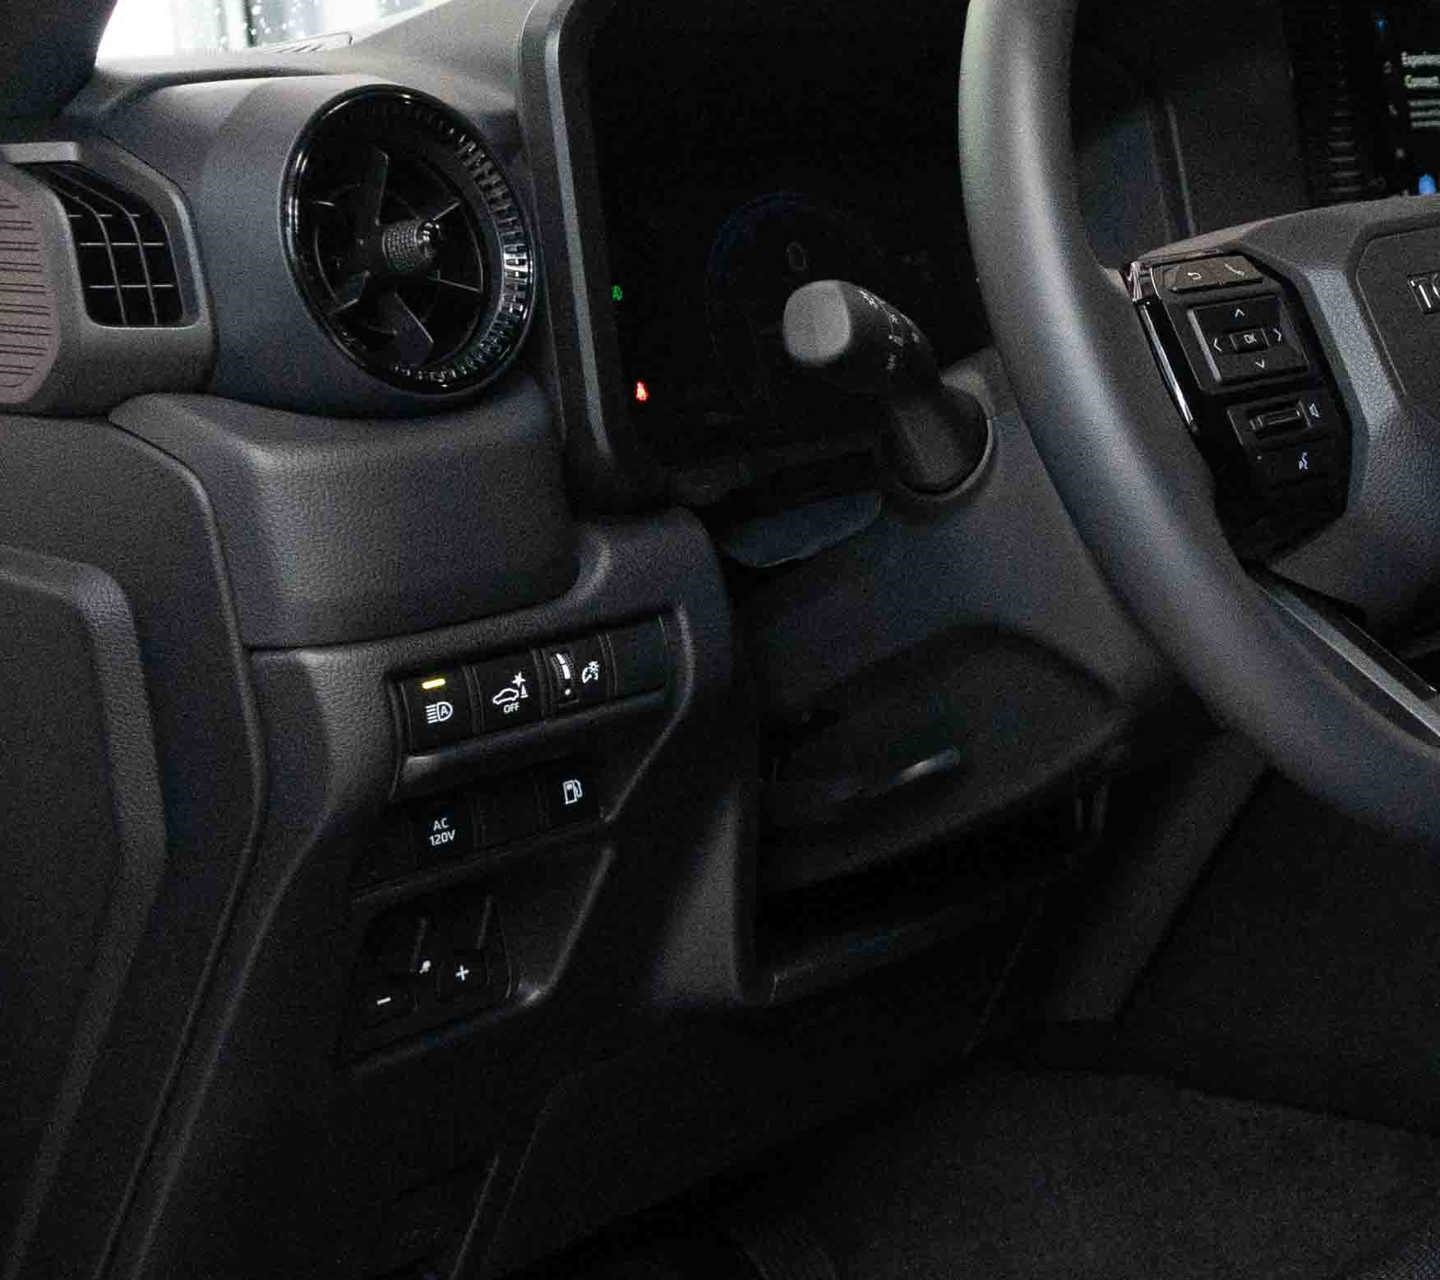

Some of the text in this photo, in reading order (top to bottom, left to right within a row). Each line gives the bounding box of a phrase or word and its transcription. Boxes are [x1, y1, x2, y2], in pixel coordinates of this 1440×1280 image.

[503, 701, 520, 714] OFF
[432, 817, 450, 832] AC
[429, 829, 457, 846] 120V
